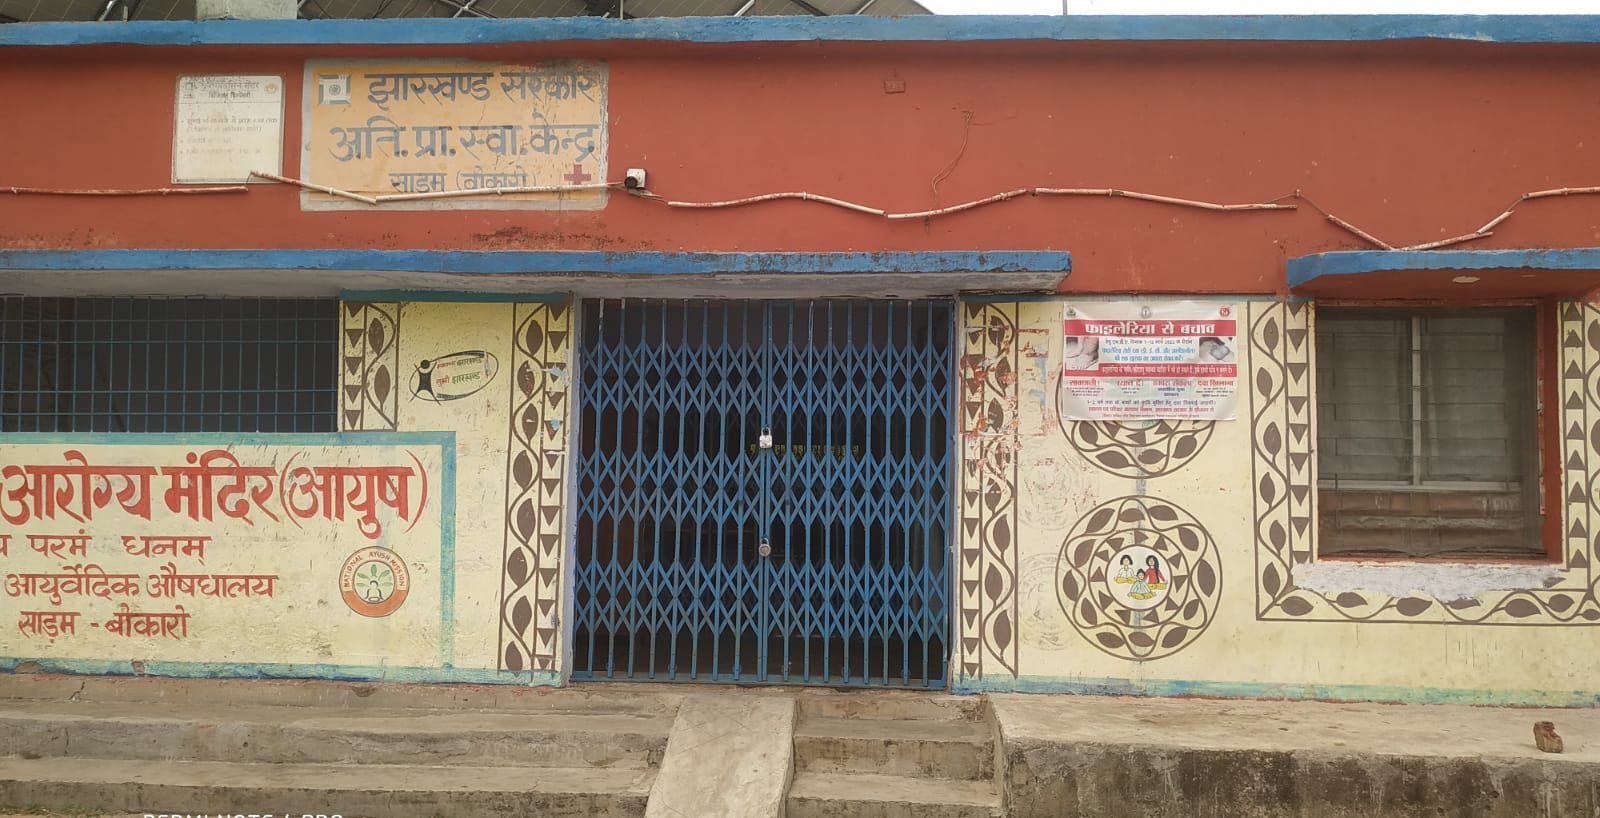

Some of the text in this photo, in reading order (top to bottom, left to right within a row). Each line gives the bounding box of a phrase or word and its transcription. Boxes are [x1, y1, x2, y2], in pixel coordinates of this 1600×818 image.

[364, 72, 598, 111] झारखण्ड सरकार
[1085, 321, 1216, 335] फाइलेरिया से बचाव
[0, 450, 158, 526] आरोग्य
[160, 449, 279, 527] मंदिर
[26, 528, 93, 560] परमं
[121, 535, 212, 563] धनम्
[5, 561, 280, 606] आयुर्वेदिक औषधालय
[343, 551, 405, 588] NATIONAL AYUSH MISSION
[18, 610, 81, 644] साड़म
